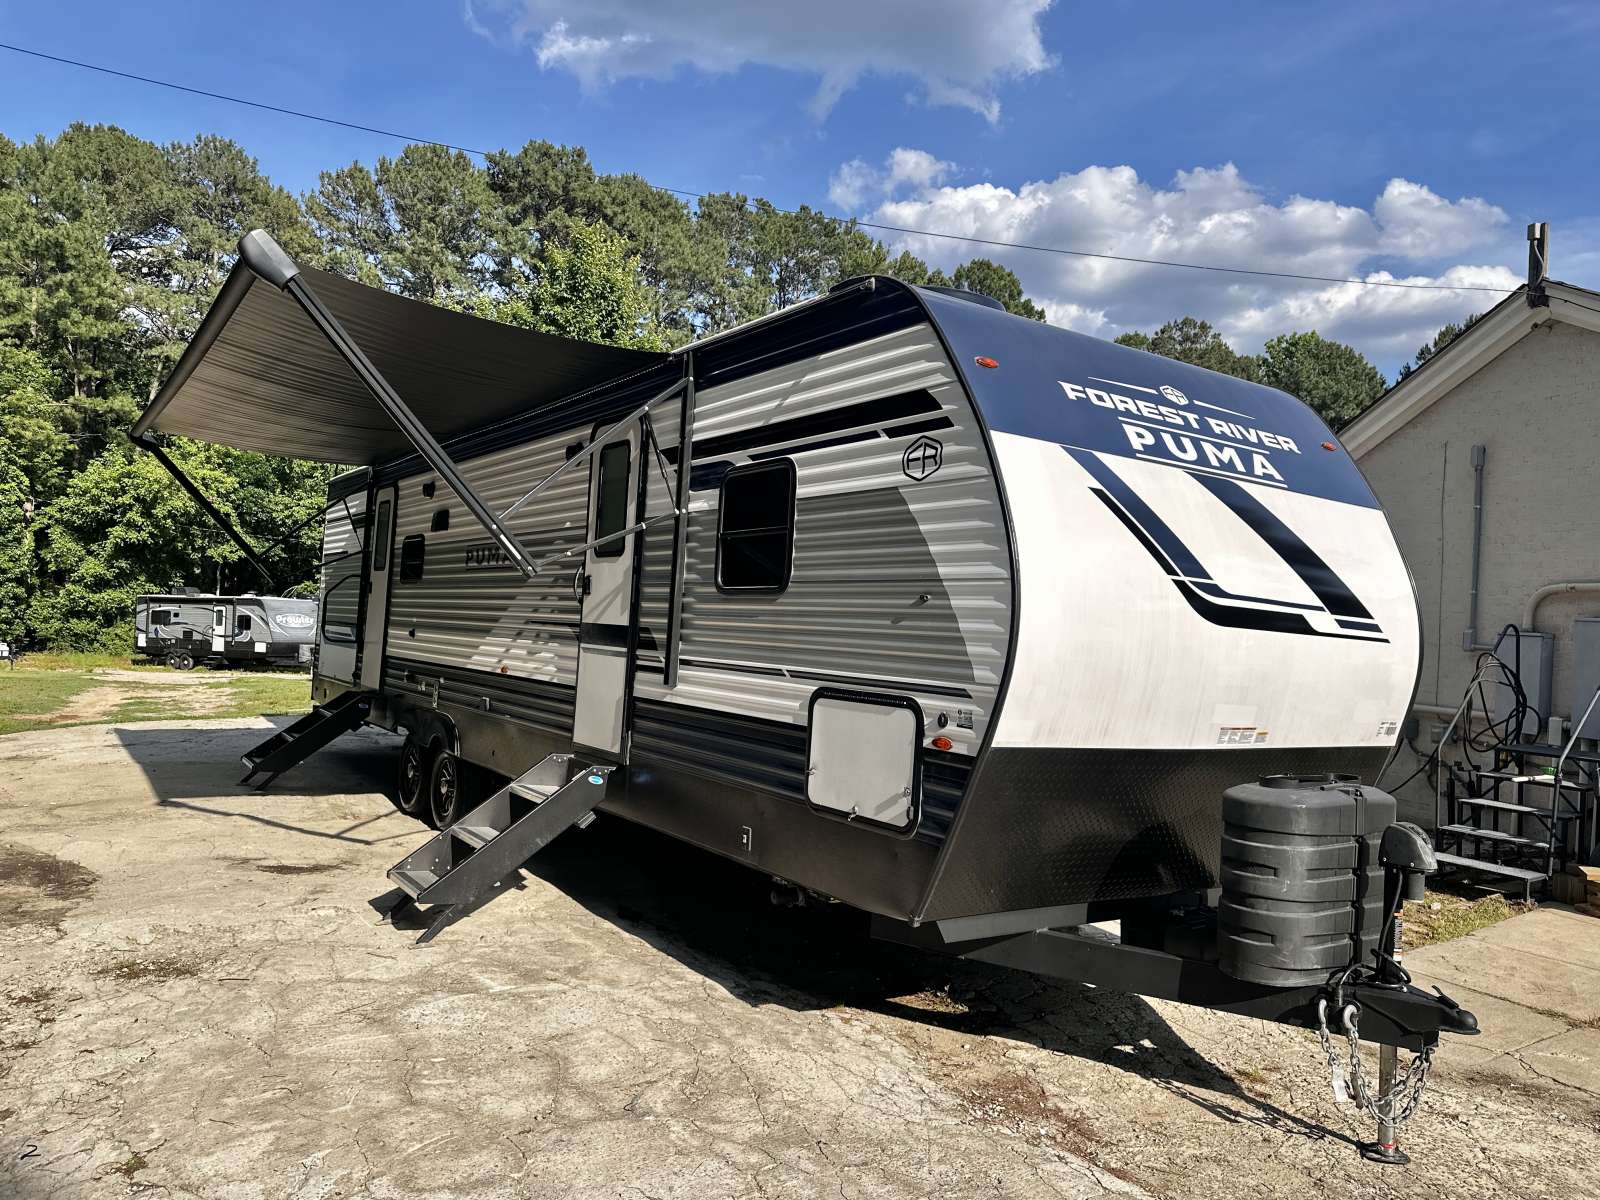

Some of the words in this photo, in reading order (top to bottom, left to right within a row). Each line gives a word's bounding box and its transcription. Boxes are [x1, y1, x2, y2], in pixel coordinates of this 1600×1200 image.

[1057, 380, 1200, 430] FOREST
[1203, 416, 1302, 455] RIVER
[1121, 423, 1285, 482] PUMA
